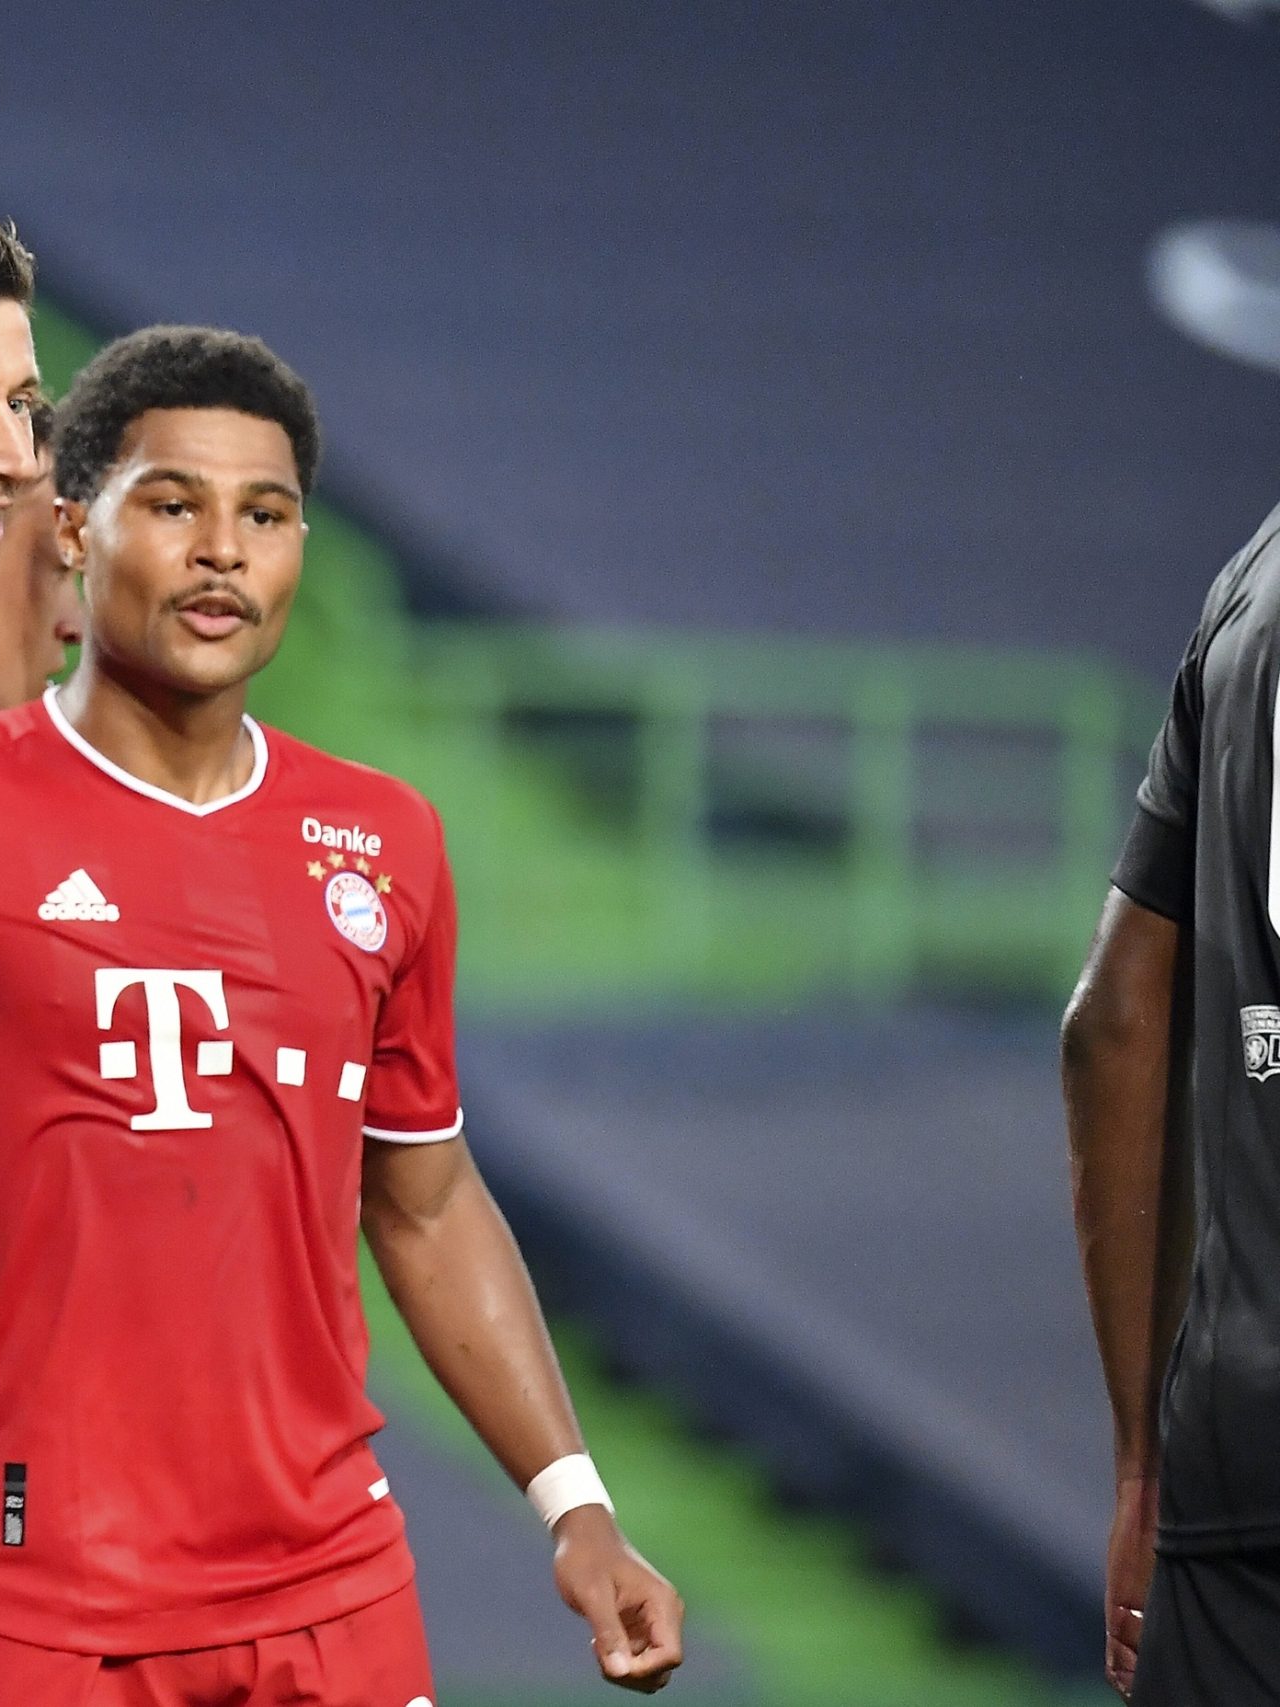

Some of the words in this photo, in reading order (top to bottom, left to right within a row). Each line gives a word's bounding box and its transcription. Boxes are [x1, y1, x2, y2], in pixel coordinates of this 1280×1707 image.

[301, 816, 382, 857] Danke
[37, 901, 121, 922] adidas
[94, 967, 230, 1131] T
